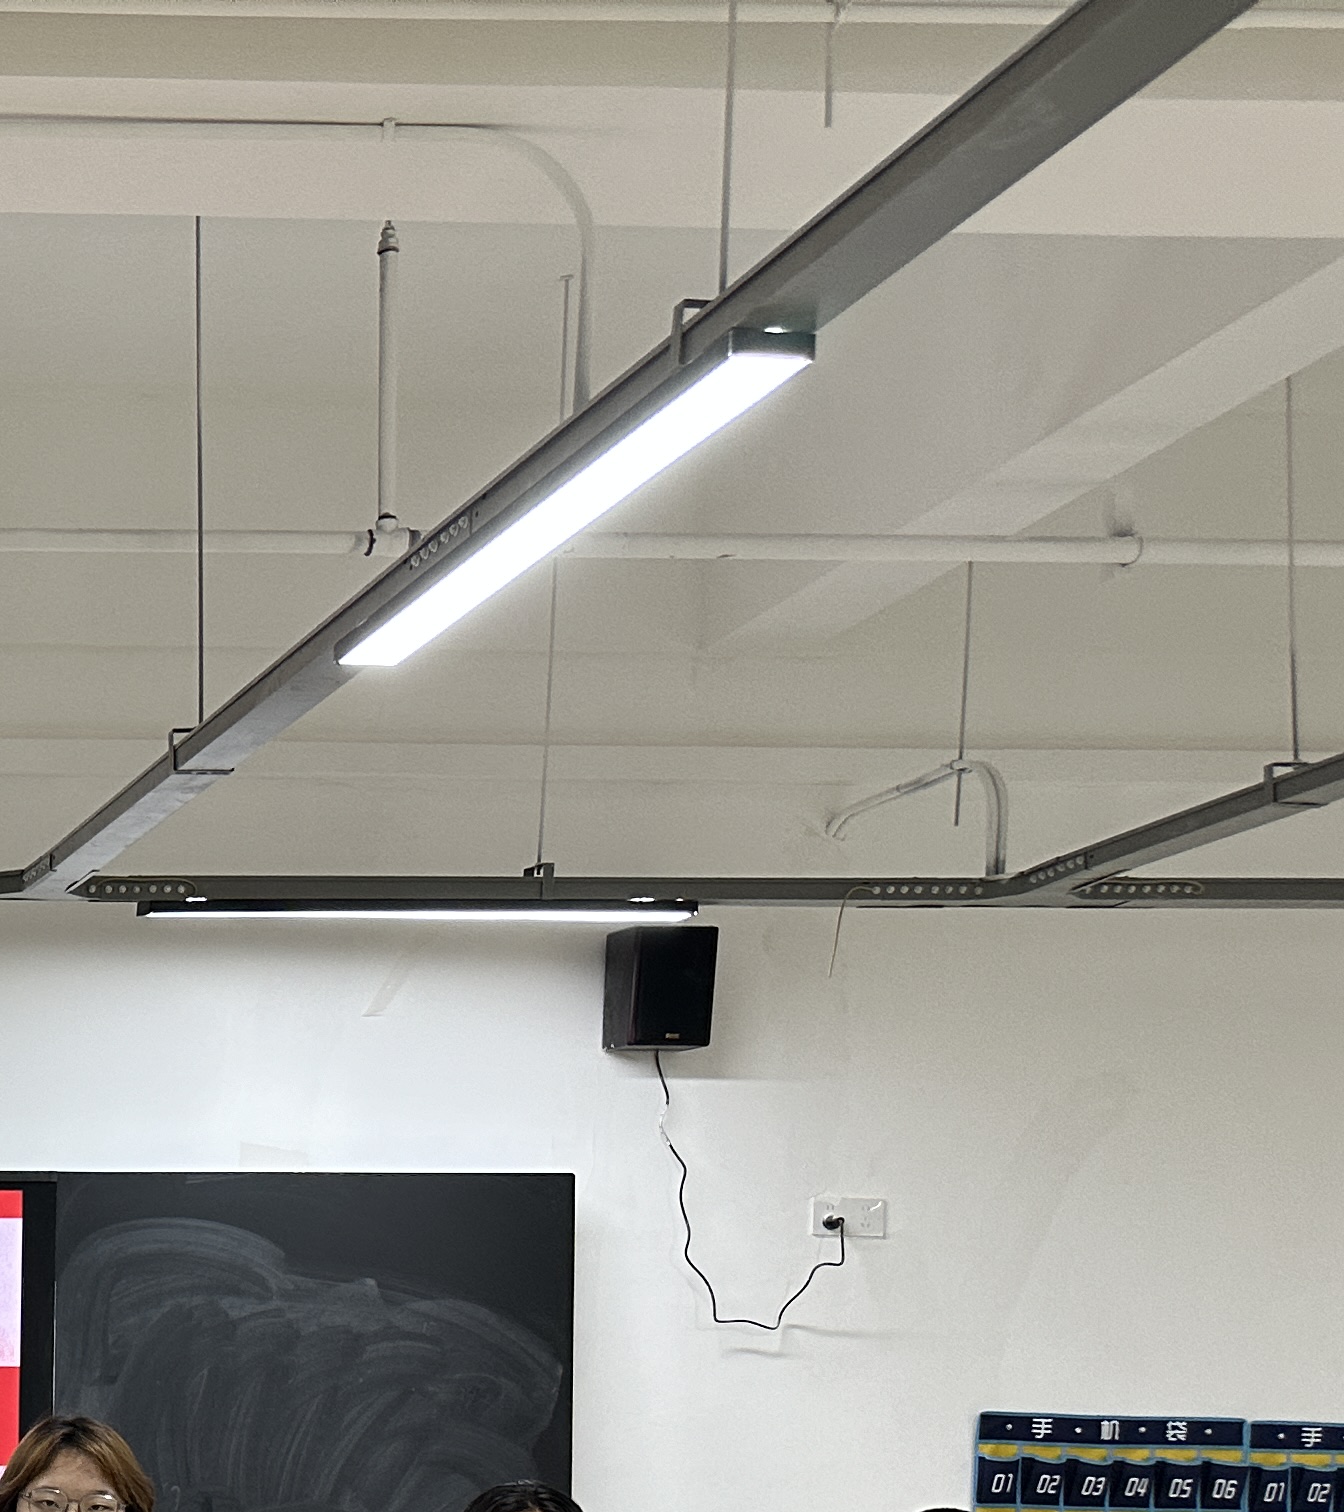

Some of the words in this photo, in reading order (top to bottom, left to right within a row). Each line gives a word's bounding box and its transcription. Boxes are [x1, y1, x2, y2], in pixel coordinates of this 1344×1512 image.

[992, 1474, 1013, 1492] 01
[1037, 1475, 1060, 1493] 02
[1081, 1477, 1105, 1495] 03
[1125, 1478, 1148, 1496] 04
[1169, 1479, 1193, 1498] 05
[1213, 1479, 1237, 1499] 06
[1264, 1483, 1285, 1502] 01
[1307, 1483, 1331, 1502] 02
